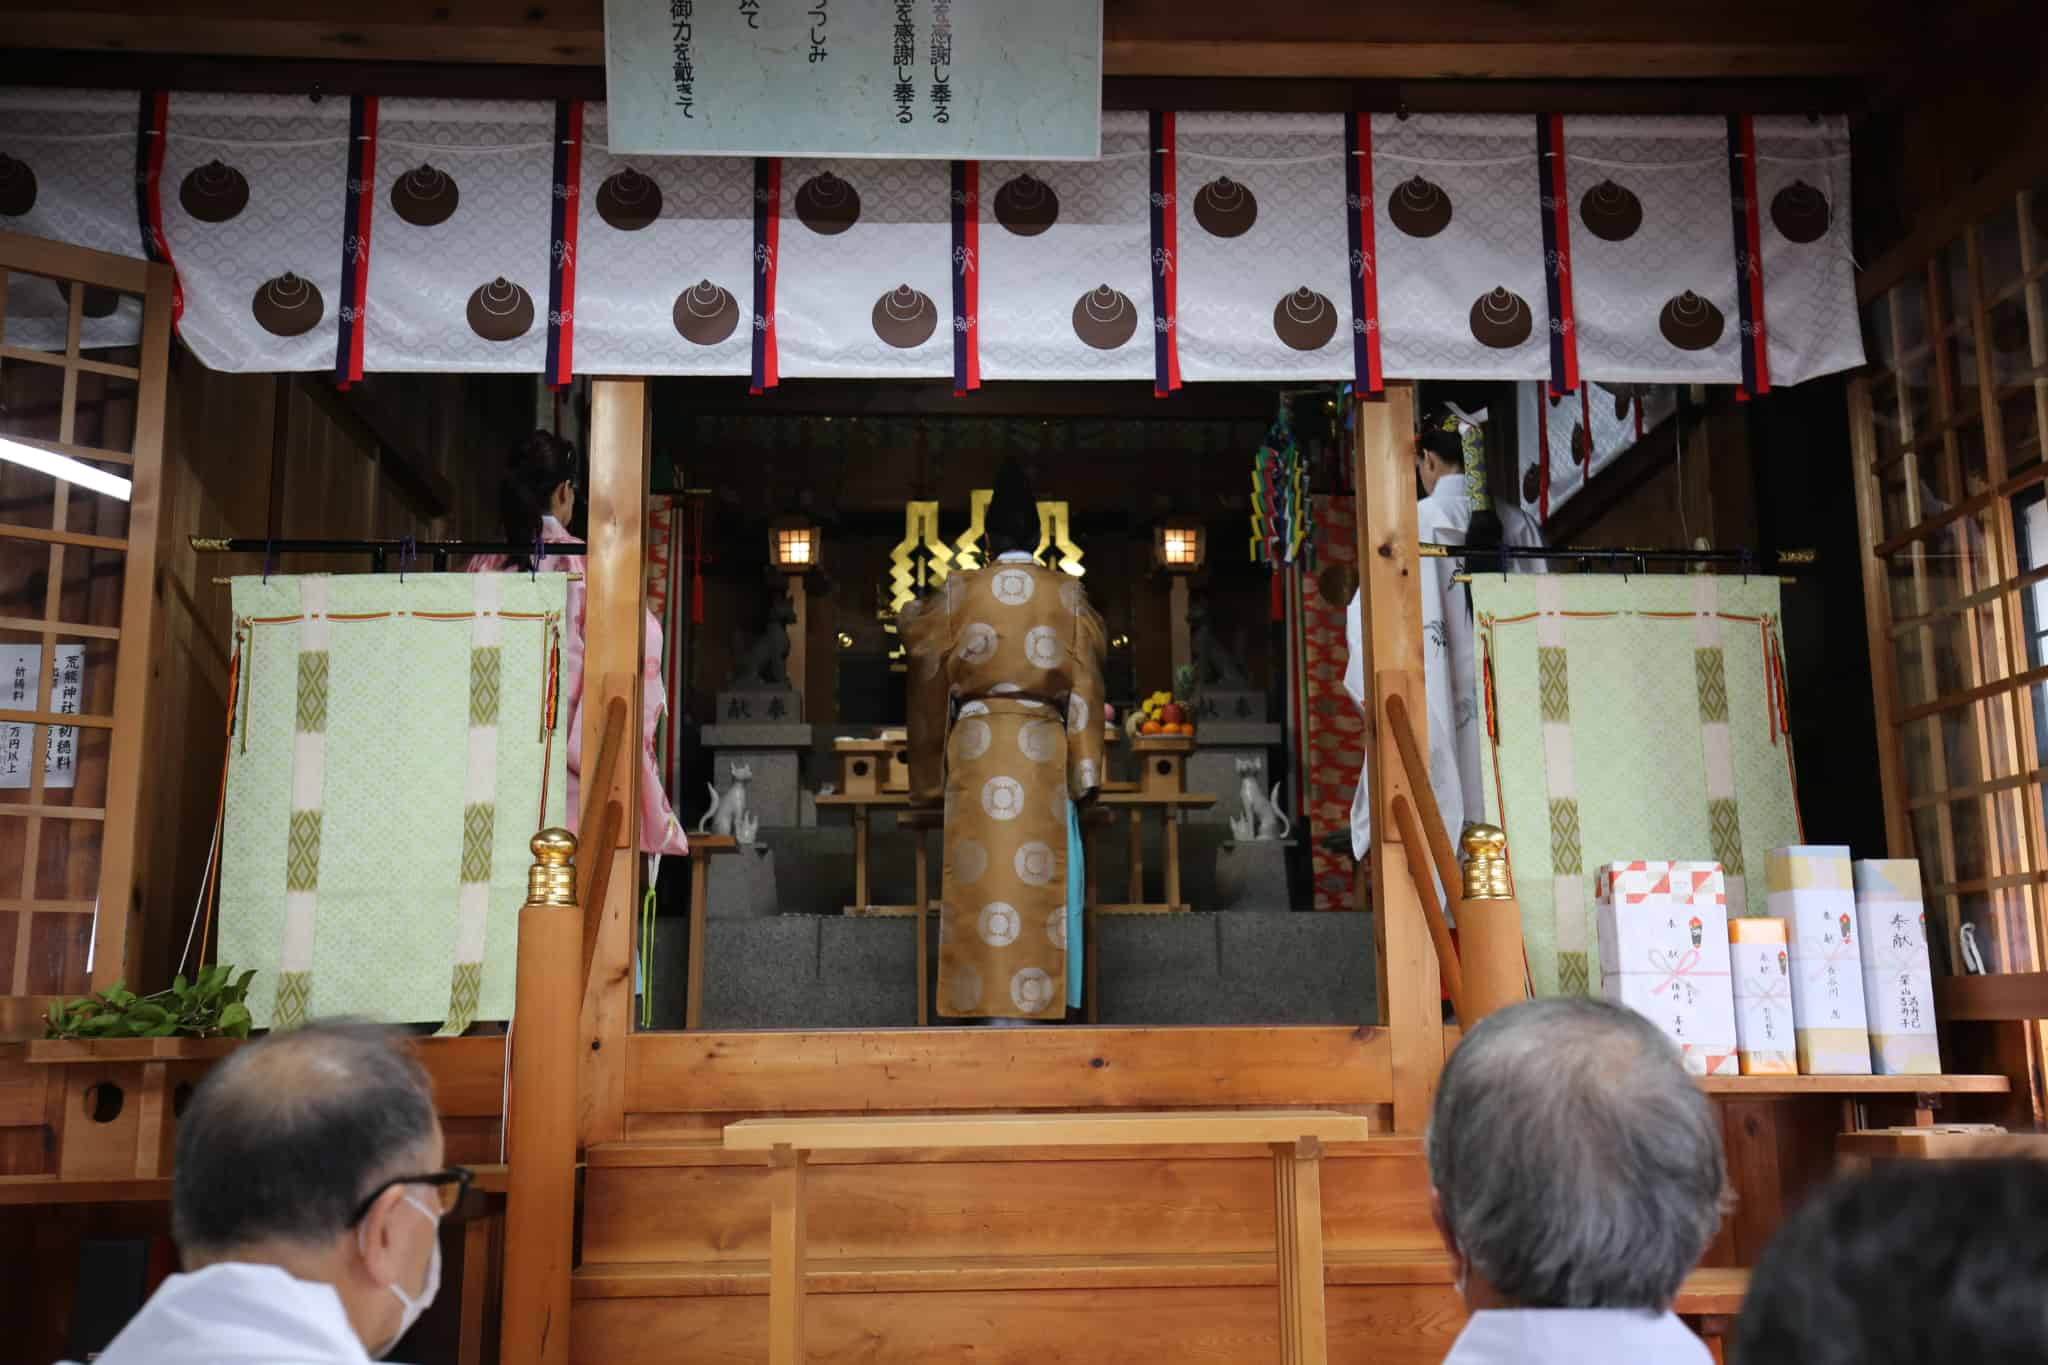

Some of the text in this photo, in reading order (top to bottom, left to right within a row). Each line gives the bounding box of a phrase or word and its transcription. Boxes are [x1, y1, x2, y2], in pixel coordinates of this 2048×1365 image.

[893, 0, 915, 124] を感謝し奉る
[930, 0, 952, 124] を感謝し奉る
[1890, 913, 1913, 949] 奉献
